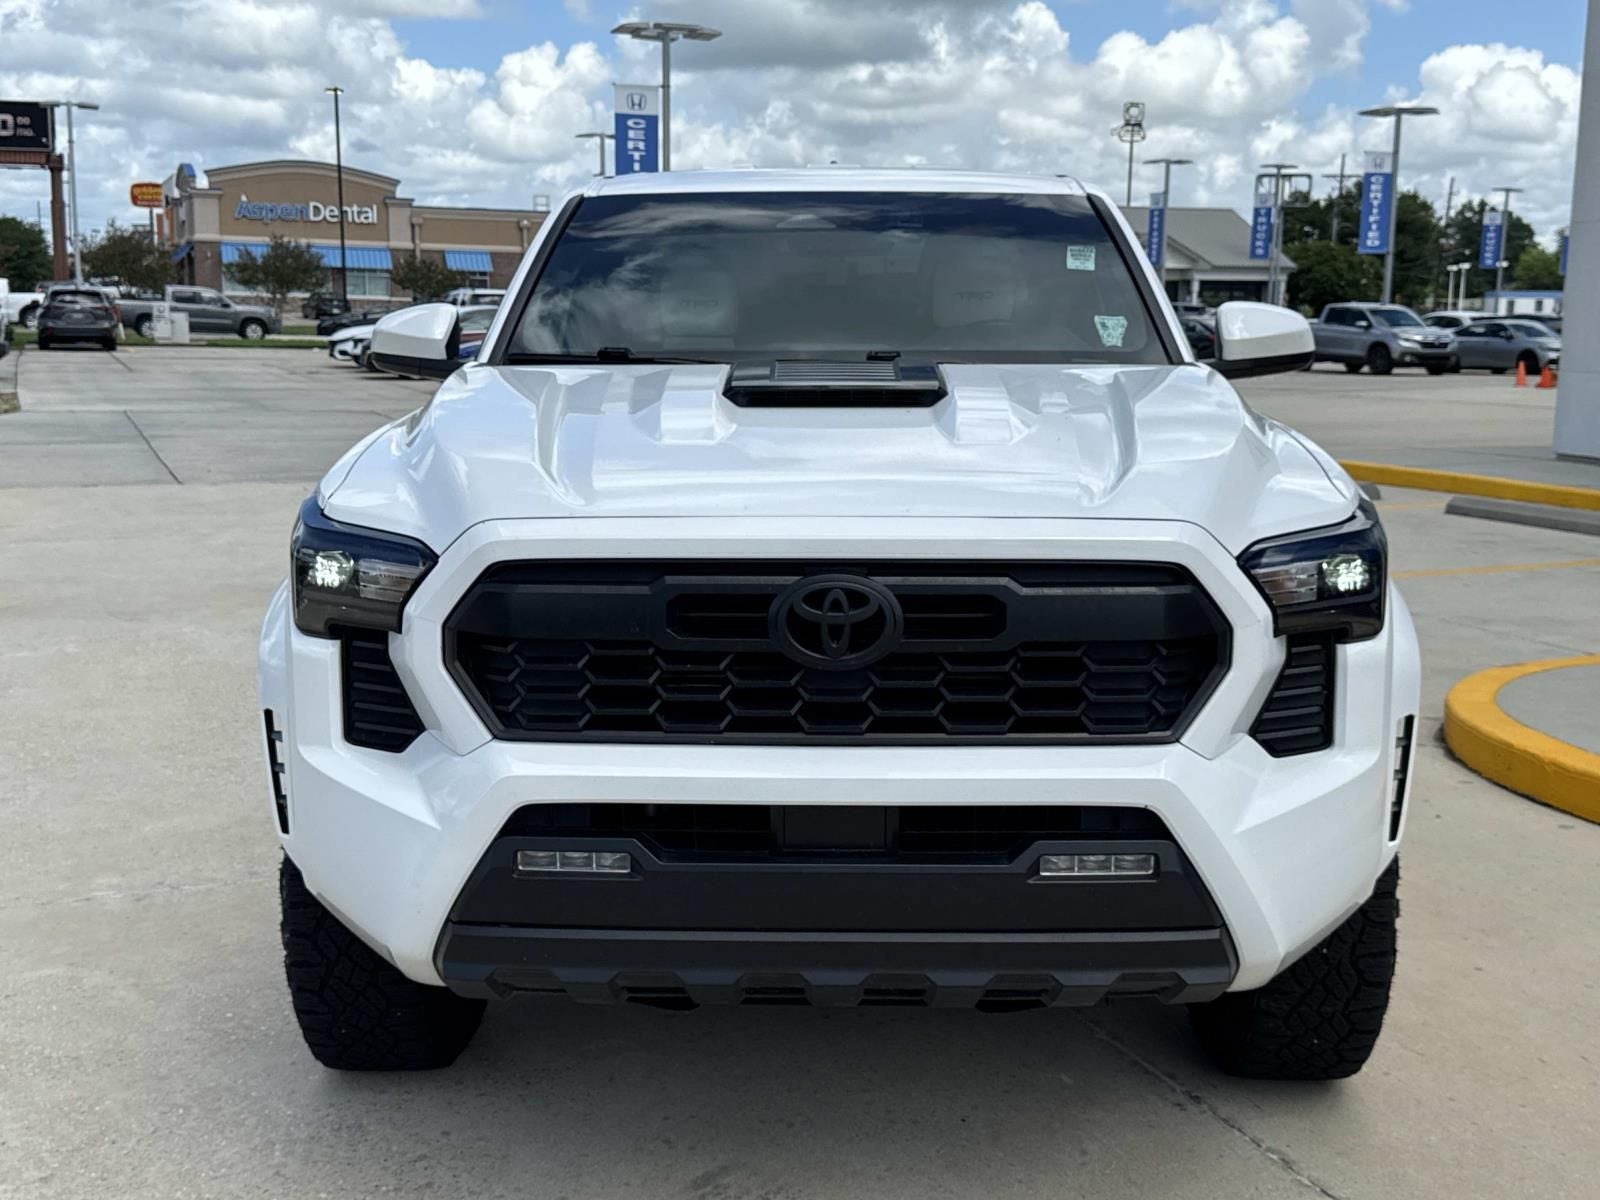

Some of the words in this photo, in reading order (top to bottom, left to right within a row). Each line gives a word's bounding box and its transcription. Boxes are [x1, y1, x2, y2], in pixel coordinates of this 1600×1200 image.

[626, 118, 647, 172] CERTI
[1255, 208, 1267, 256] TRUCKS
[1366, 175, 1385, 248] CERTIFIED
